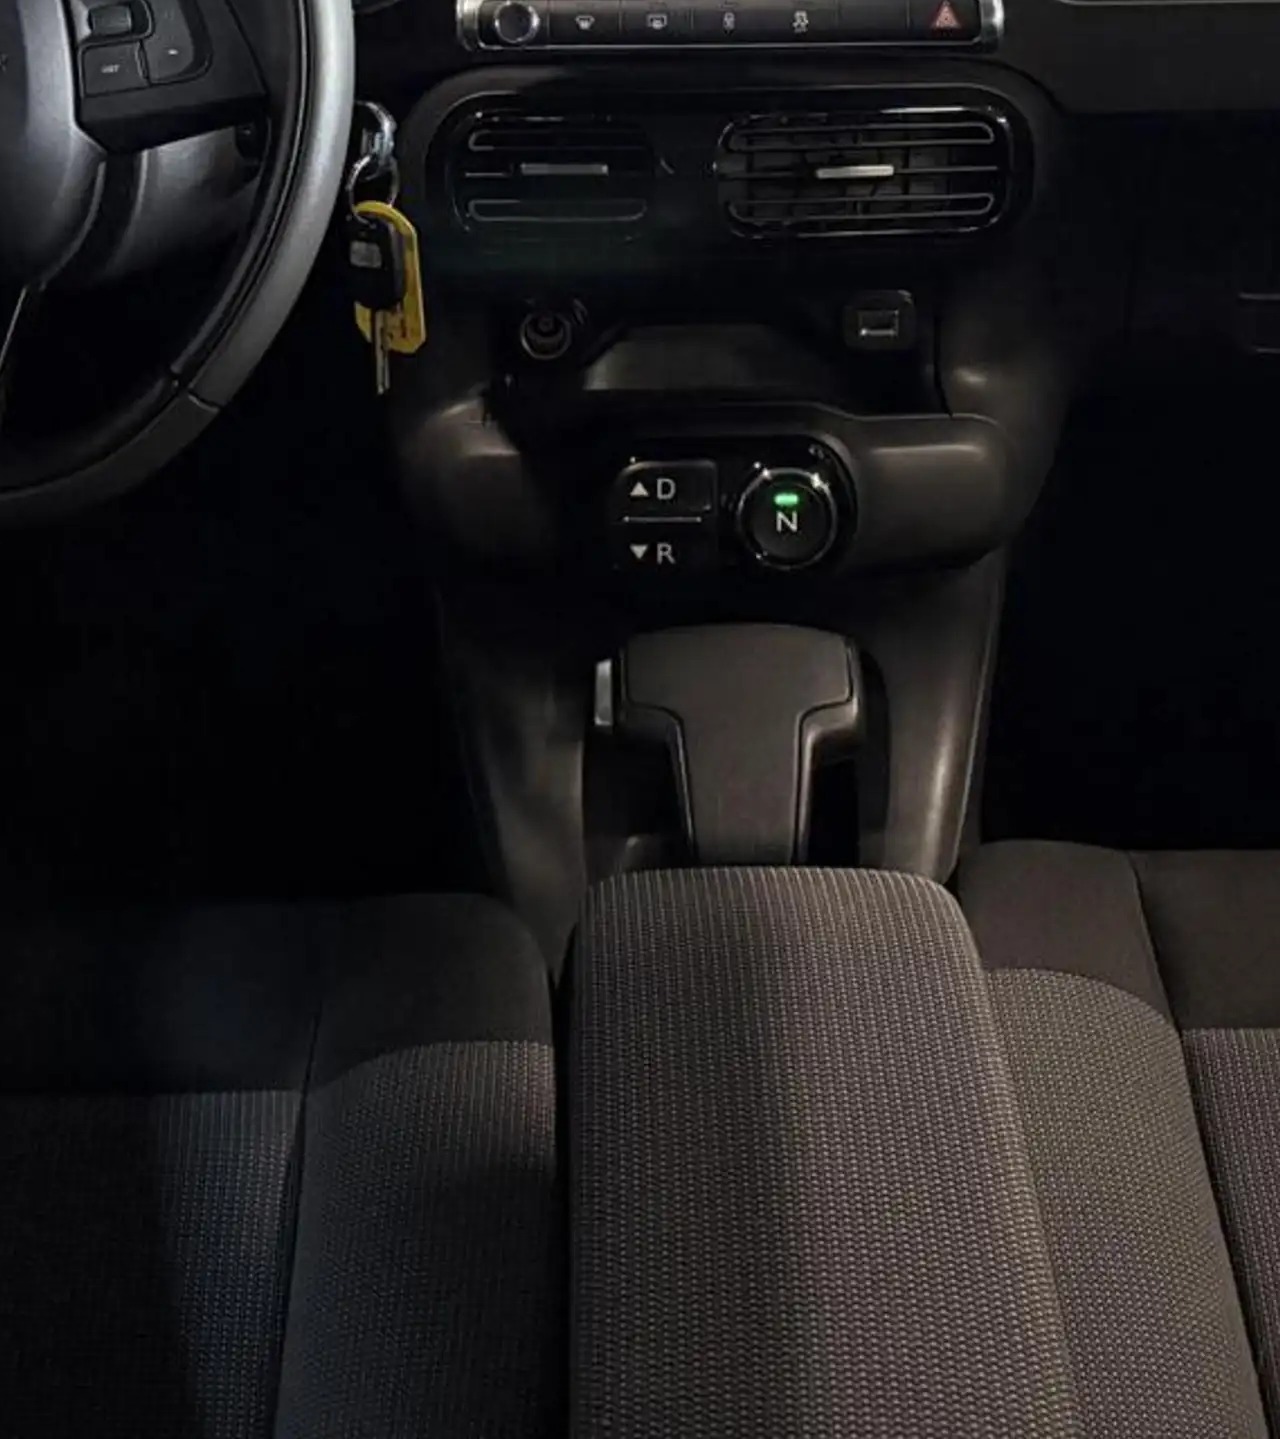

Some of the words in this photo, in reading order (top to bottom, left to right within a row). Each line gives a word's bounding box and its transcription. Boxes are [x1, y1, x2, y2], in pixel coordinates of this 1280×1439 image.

[656, 478, 676, 500] D
[776, 511, 798, 533] N
[656, 543, 676, 565] R
